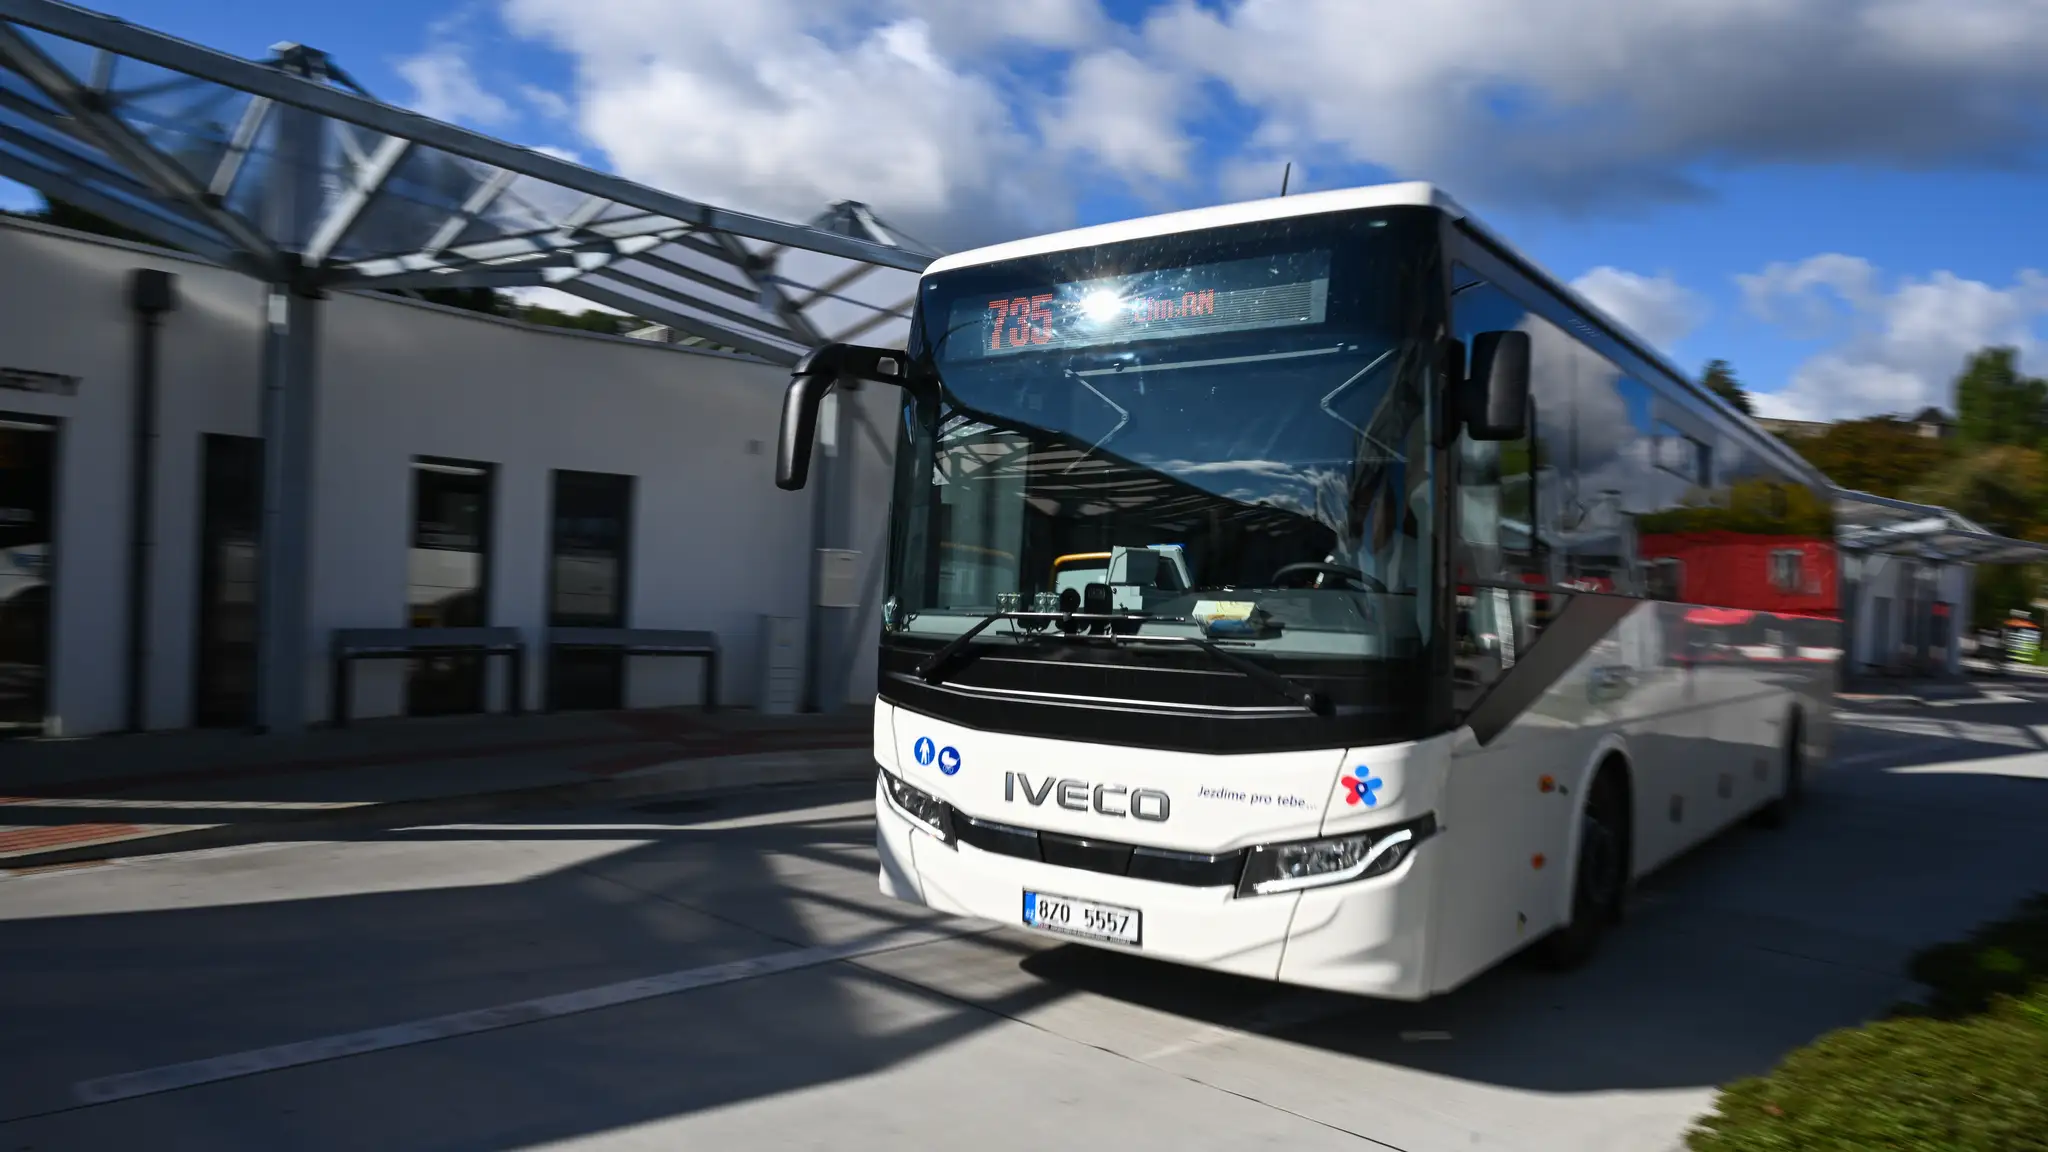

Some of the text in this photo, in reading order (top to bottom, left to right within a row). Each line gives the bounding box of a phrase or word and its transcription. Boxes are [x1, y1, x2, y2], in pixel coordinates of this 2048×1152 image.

[989, 294, 1052, 349] 735
[1005, 771, 1170, 822] IVECO
[1250, 793, 1272, 806] pro
[1084, 908, 1130, 935] 5557
